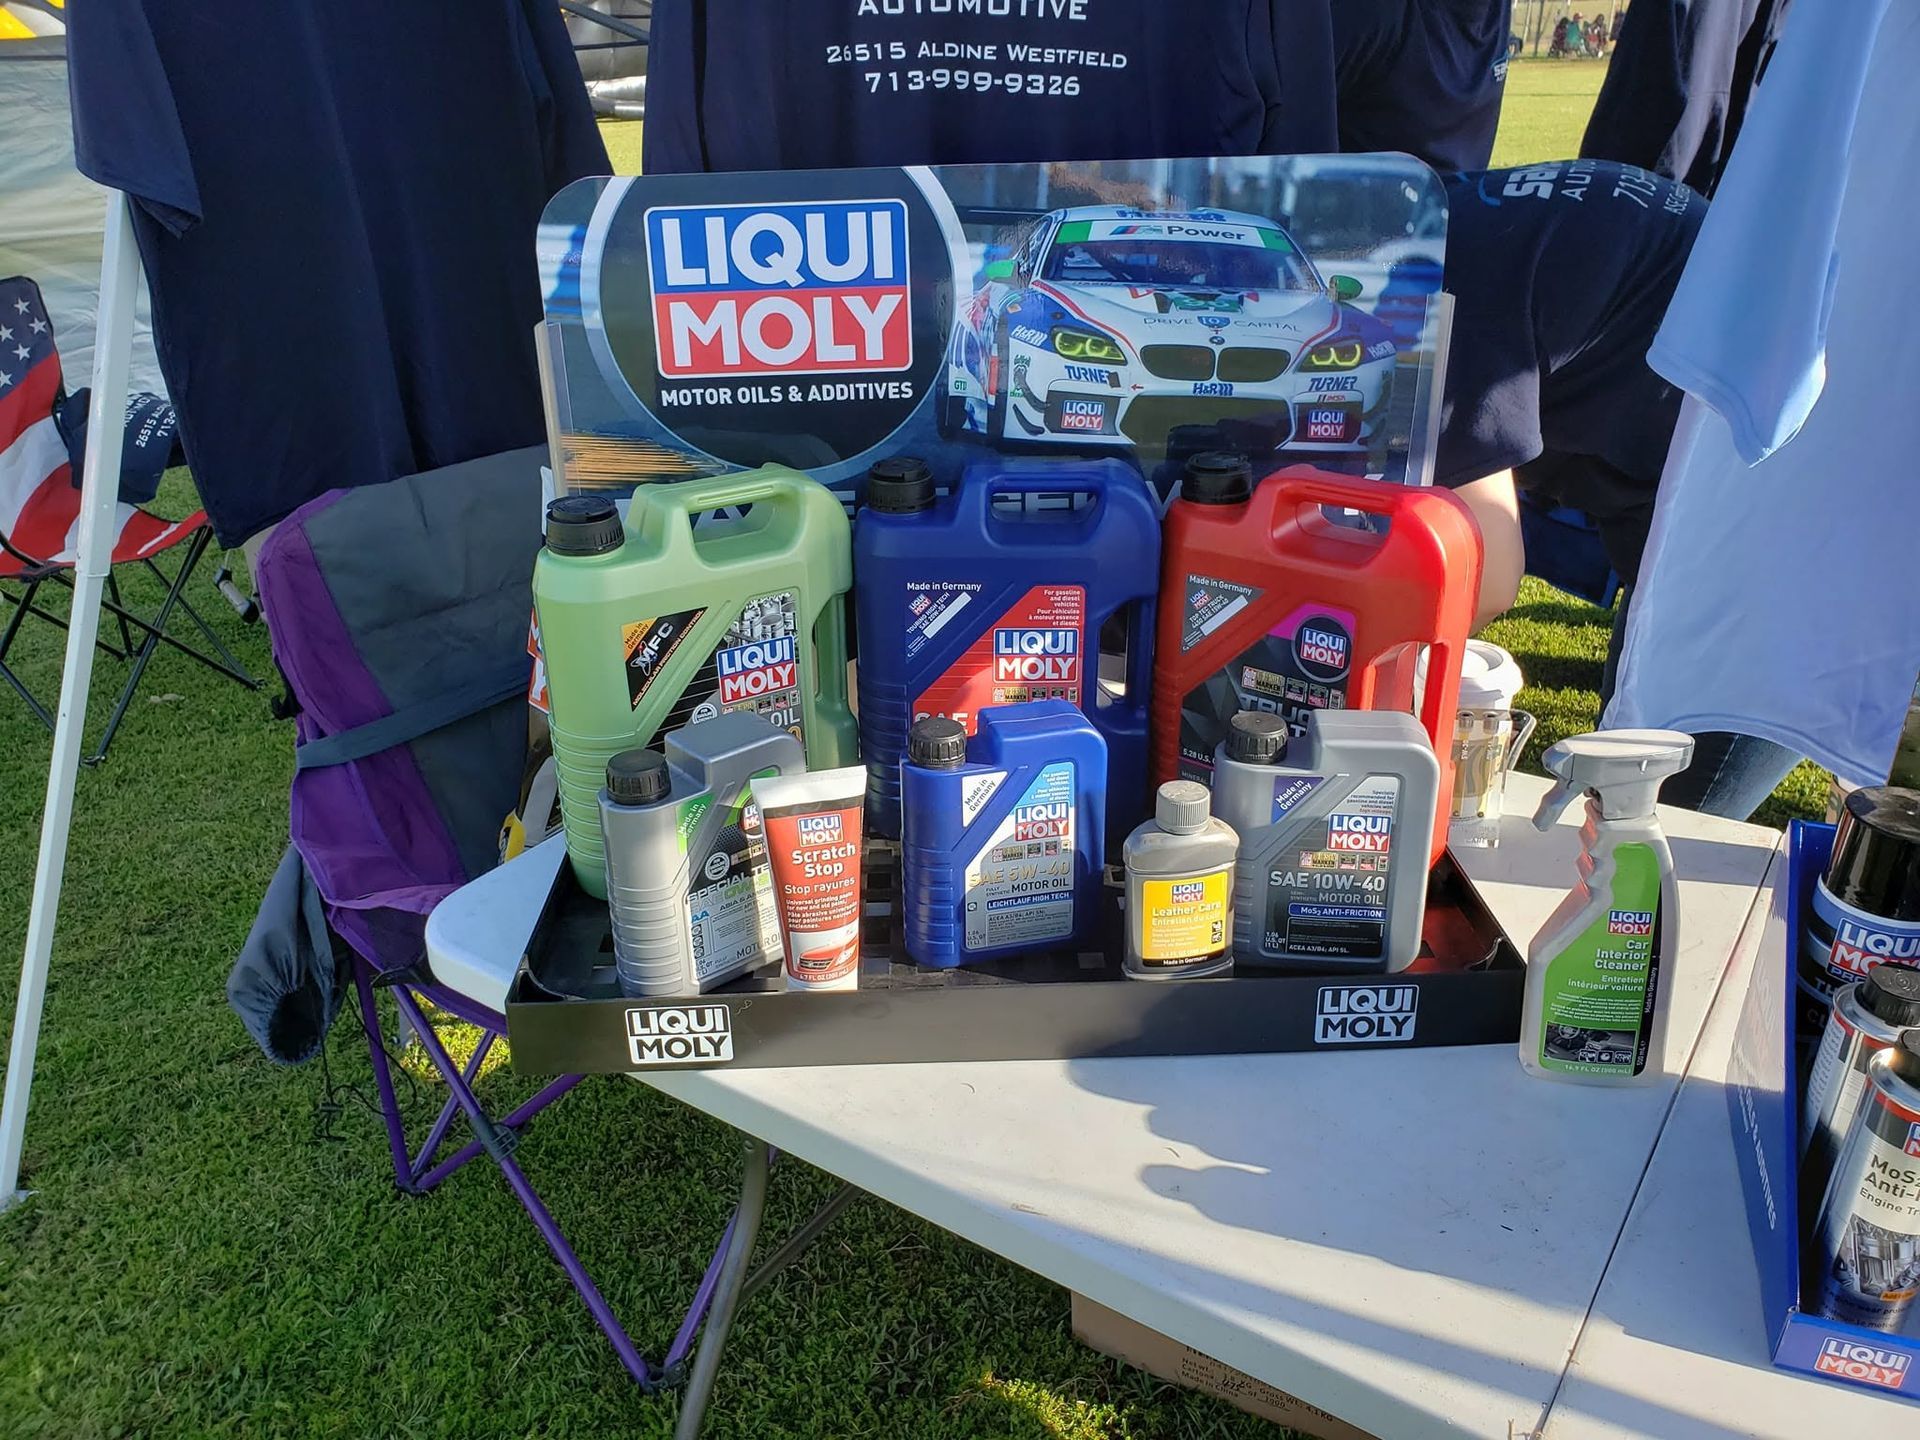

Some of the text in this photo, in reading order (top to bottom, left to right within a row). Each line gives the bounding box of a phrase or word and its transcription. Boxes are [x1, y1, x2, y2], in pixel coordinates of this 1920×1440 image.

[826, 41, 1128, 68] 26515 ALDINE WESTFIELD
[1167, 225, 1245, 240] Power
[661, 210, 893, 287] LIQUI
[669, 294, 903, 367] MOLY
[1234, 320, 1303, 332] CAPITAL
[1309, 376, 1358, 391] TURNER
[661, 382, 913, 406] MOTOR OILS & ADDITIVES
[1065, 402, 1103, 416] LIQUI
[1311, 411, 1343, 424] LIQUI
[1064, 415, 1102, 428] MOLY
[1310, 424, 1343, 436] MOLY
[136, 418, 157, 448] 26515
[907, 582, 981, 592] Made in Germany
[1189, 575, 1252, 596] Made in Germany
[624, 628, 639, 644] Made
[628, 624, 649, 650] Germany
[640, 622, 674, 662] MFC
[999, 631, 1073, 655] LIQUI
[1304, 631, 1344, 651] LIQUI
[721, 639, 790, 675] LIQUI
[1303, 645, 1344, 666] MOLY
[998, 657, 1075, 680] MOLY
[724, 663, 793, 700] MOLY
[771, 708, 800, 727] OIL
[1183, 748, 1197, 759] 5.28
[964, 778, 988, 806] Made in
[969, 780, 996, 812] Germany
[1275, 779, 1304, 804] Made in
[1280, 782, 1312, 810] Germany
[1017, 803, 1067, 823] LIQUI
[678, 812, 693, 835] Made
[801, 816, 839, 832] LIQUI
[1017, 821, 1068, 840] MOLY
[1332, 816, 1388, 834] LIQUI
[801, 829, 840, 845] MOLY
[1330, 833, 1388, 851] MOLY
[792, 843, 856, 864] Scratch
[804, 862, 843, 878] Stop
[1009, 861, 1071, 881] 5W-40
[687, 872, 748, 901] SPECIAL
[785, 877, 855, 895] Stop rayures
[1012, 880, 1049, 893] MOTOR
[1052, 878, 1069, 887] OIL
[1173, 883, 1202, 894] LIQUI
[1269, 871, 1385, 891] SAE 10W-40
[988, 896, 1032, 909] LEICHTLAUF
[1032, 894, 1050, 902] HIGH
[1173, 893, 1202, 903] MOLY
[1318, 892, 1360, 904] MOTOR
[1364, 894, 1383, 905] OIL
[1152, 902, 1221, 917] Leather Care
[1322, 908, 1382, 918] ANTI-FRICTION
[1611, 912, 1650, 923] LIQUI
[1152, 917, 1192, 926] Entretien
[1609, 923, 1650, 934] MOLY
[1597, 949, 1648, 960] Interior
[1626, 940, 1649, 950] Car
[1185, 956, 1208, 964] Germany
[1594, 960, 1646, 970] Cleaner
[1601, 975, 1644, 984] Entretien
[1611, 983, 1643, 991] voiture
[1323, 988, 1413, 1013] LIQUI
[632, 1008, 724, 1035] LIQUI
[1322, 1015, 1412, 1039] MOLY
[636, 1035, 728, 1060] MOLY
[1755, 1139, 1777, 1231] ADDITIVES
[1860, 1187, 1902, 1213] Engine
[1826, 1340, 1906, 1370] LIQUI
[1820, 1356, 1902, 1384] MOLY
